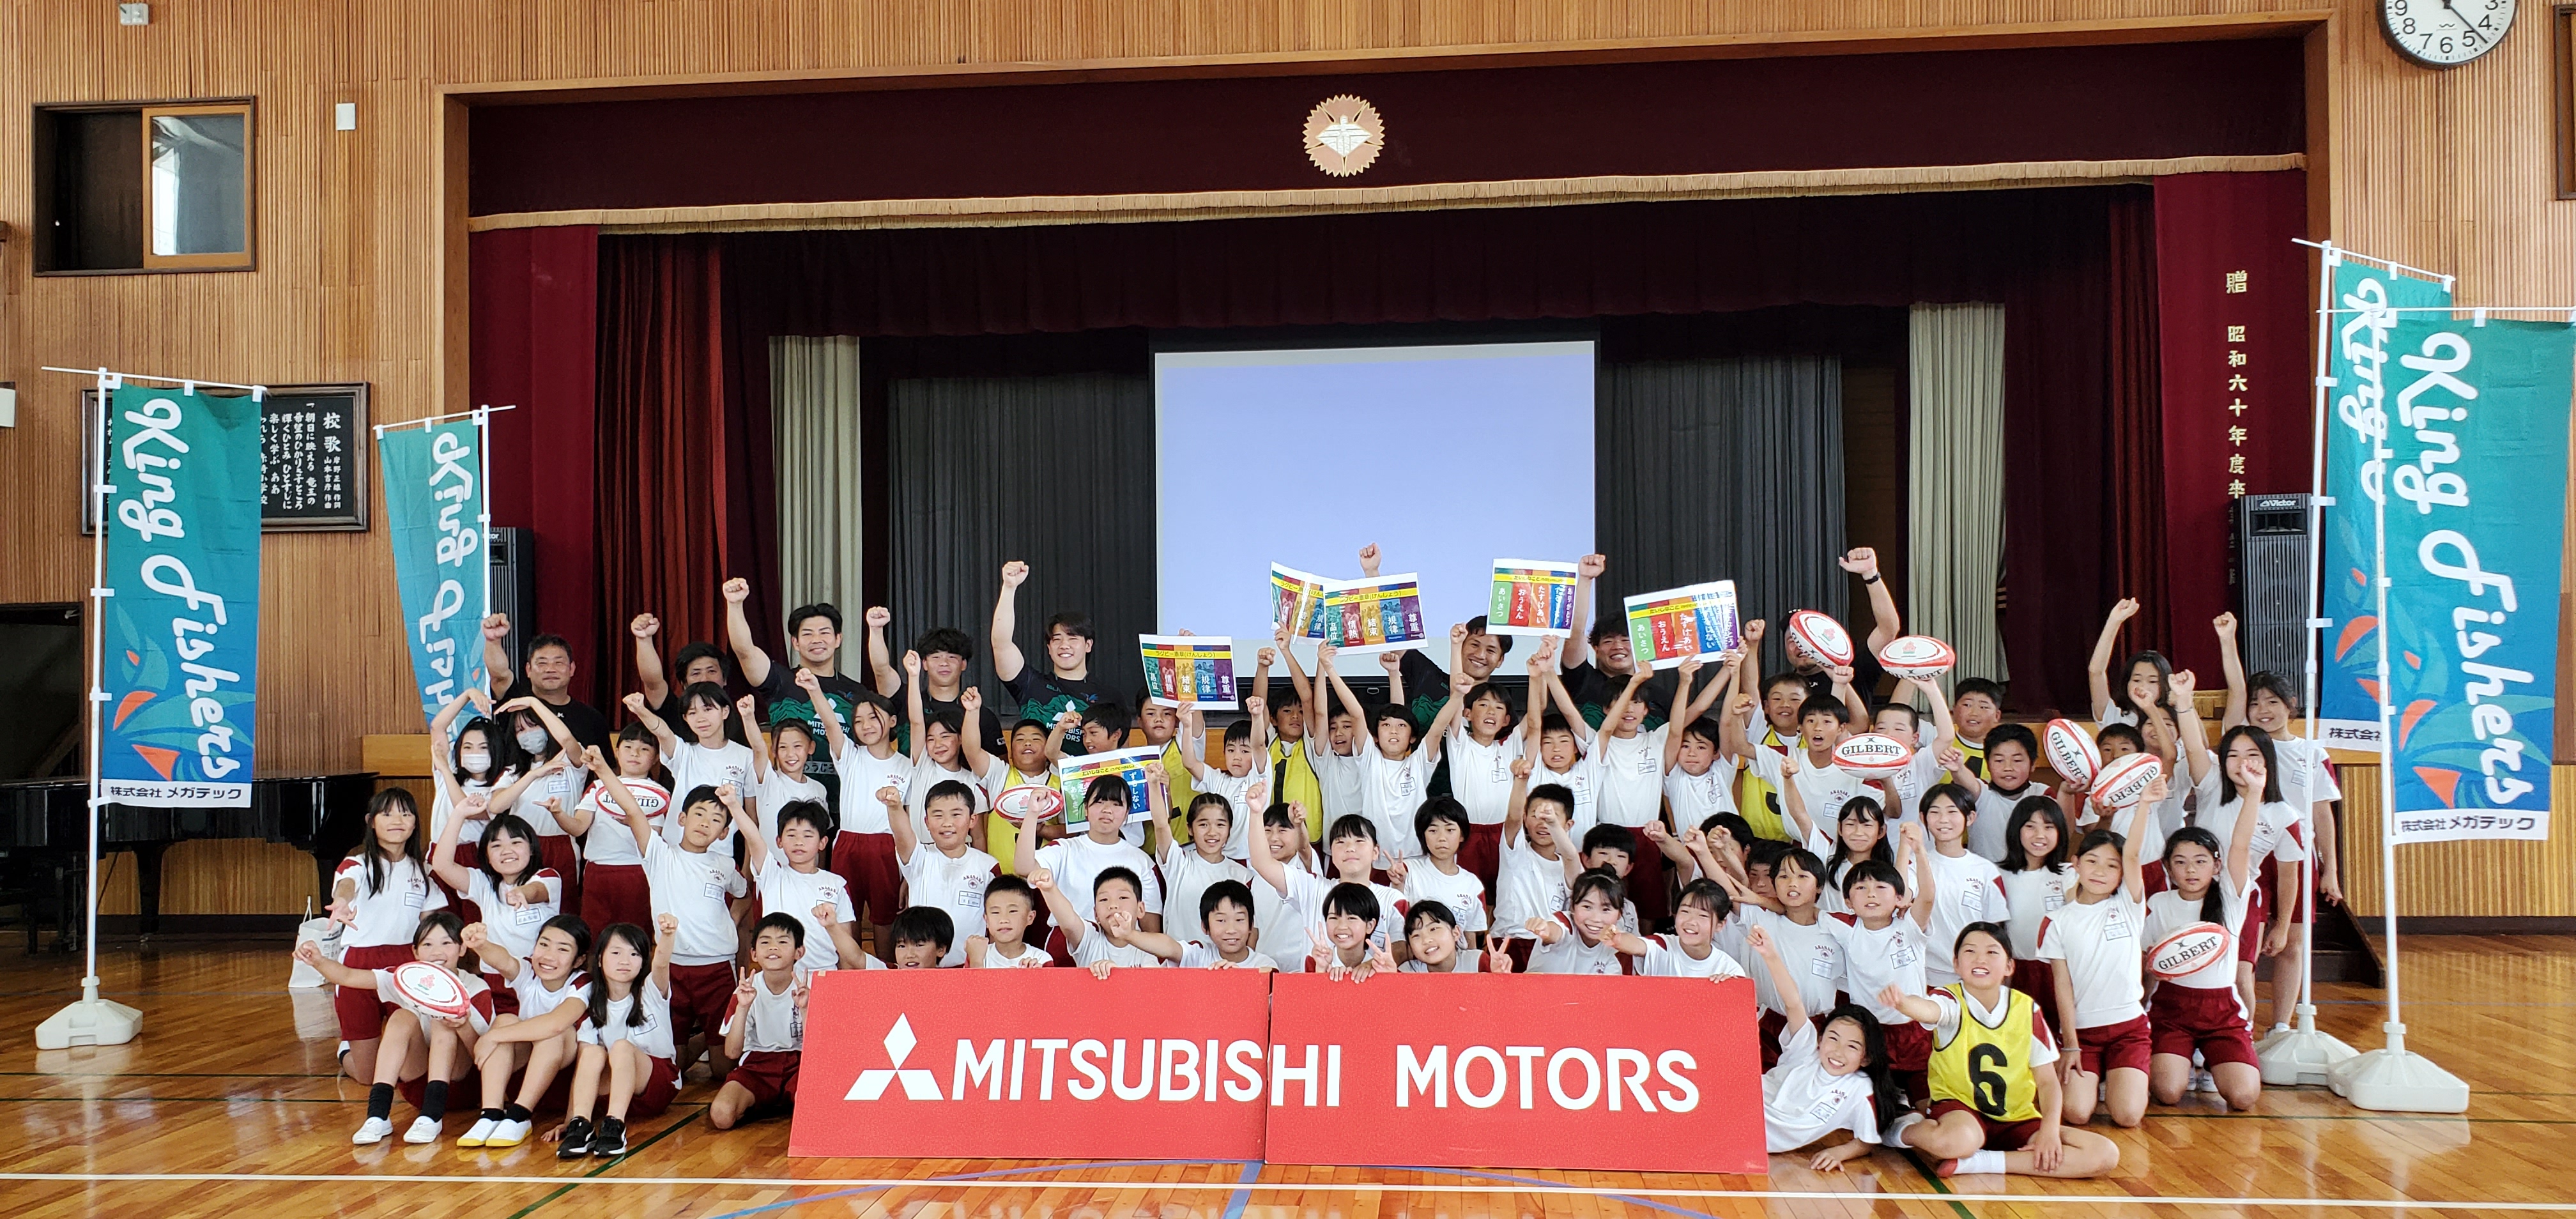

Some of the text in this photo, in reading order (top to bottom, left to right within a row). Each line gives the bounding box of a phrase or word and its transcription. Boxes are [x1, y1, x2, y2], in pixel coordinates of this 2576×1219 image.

[2395, 0, 2407, 16] 9
[2403, 17, 2416, 34] 8
[2478, 14, 2492, 30] 4
[2419, 33, 2432, 49] 7
[2440, 36, 2453, 54] 6
[2462, 30, 2476, 47] 5
[2339, 278, 2389, 444] King
[323, 412, 342, 453] 校歌
[2226, 270, 2248, 585] 贈 昭和六十年度卒
[2393, 332, 2534, 804] King Fishers
[118, 398, 241, 779] King Fishers
[1496, 587, 1506, 617] あいさつ
[1515, 588, 1526, 620] おうえん
[1537, 585, 1545, 624] たすけあい
[1388, 615, 1399, 634] 規律
[1637, 624, 1649, 654] あいさつ
[1657, 620, 1670, 652] おうえん
[1201, 675, 1211, 694] 規律
[2329, 727, 2382, 741] 株式会
[1841, 744, 1901, 756] GILBERT
[2051, 732, 2088, 784] GILBERT
[110, 786, 241, 799] 株式会社 メガテック
[603, 794, 659, 808] GILT
[1830, 790, 1850, 798] AKASAKI
[2401, 815, 2536, 832] 株式会社 メガテック
[963, 875, 984, 884] AKASAKI
[2158, 935, 2218, 970] GILBERT
[952, 1038, 1700, 1113] MITSUBISHI MOTORS
[1969, 1043, 2007, 1117] 6
